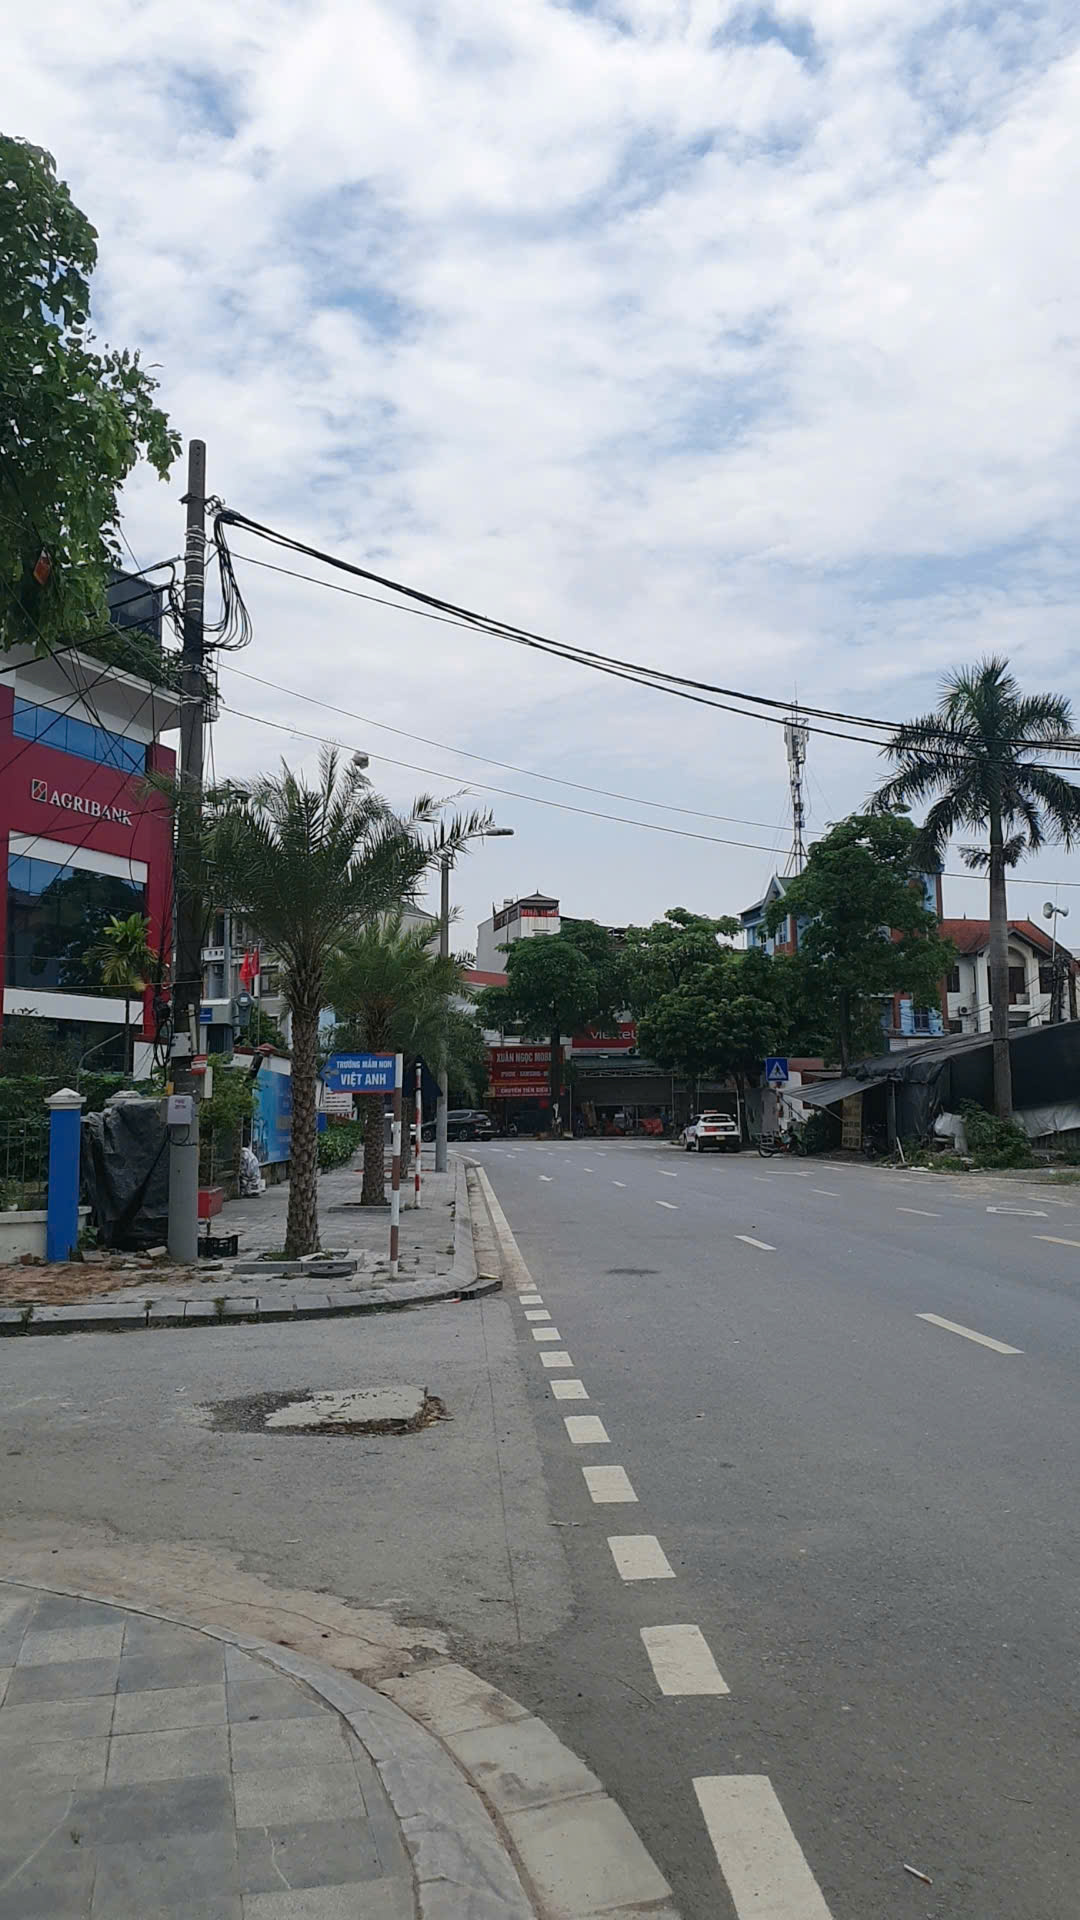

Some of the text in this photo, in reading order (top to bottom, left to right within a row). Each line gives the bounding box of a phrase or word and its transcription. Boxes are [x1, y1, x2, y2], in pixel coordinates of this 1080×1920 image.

[49, 790, 133, 827] AGRIBANK
[336, 1058, 393, 1069] TRƯỜNG MẦM NON
[515, 1052, 533, 1064] NGỌC
[340, 1072, 387, 1087] VIỆT ANH
